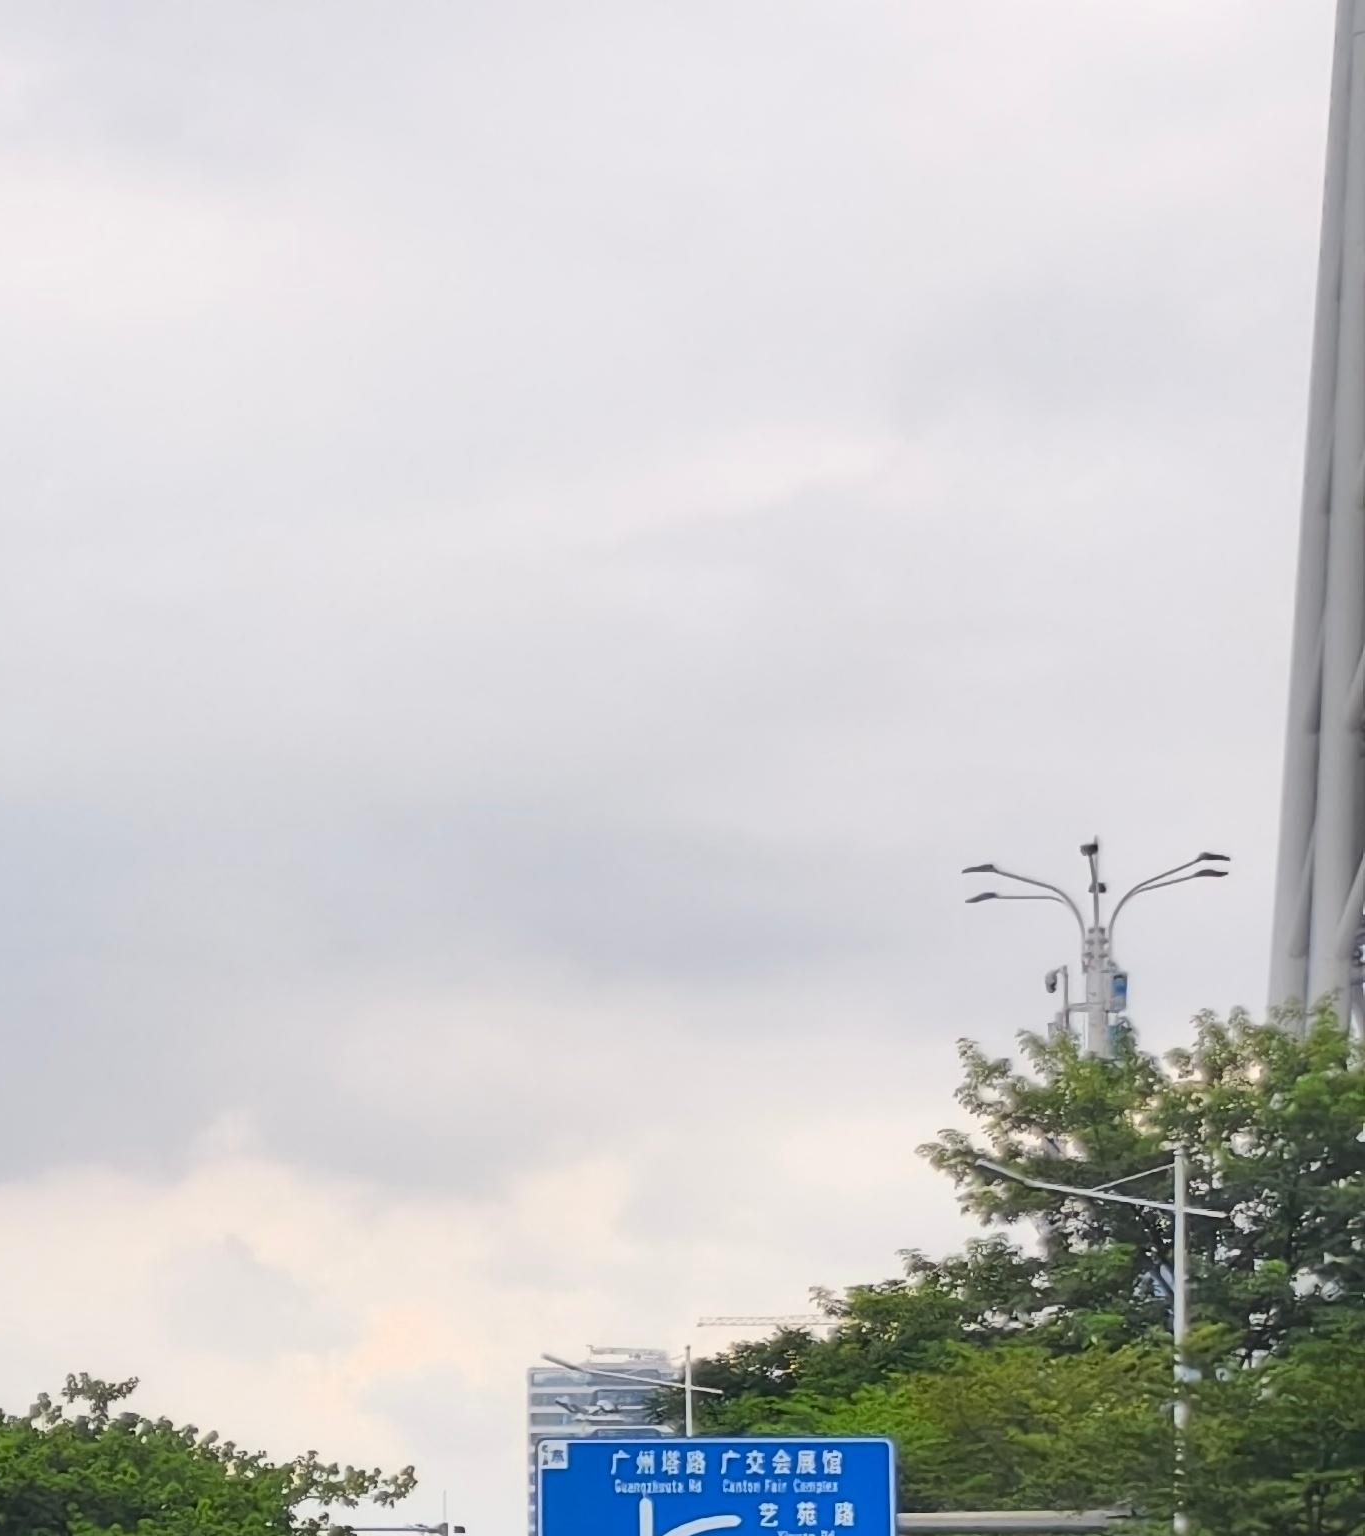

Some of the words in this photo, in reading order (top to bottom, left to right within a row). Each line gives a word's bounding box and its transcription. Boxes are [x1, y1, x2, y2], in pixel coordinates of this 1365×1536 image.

[610, 1449, 707, 1476] 广州塔路
[720, 1449, 844, 1476] 广交会展馆
[722, 1479, 761, 1494] Canton
[764, 1479, 788, 1494] Fair
[759, 1502, 855, 1527] 艺苑路
